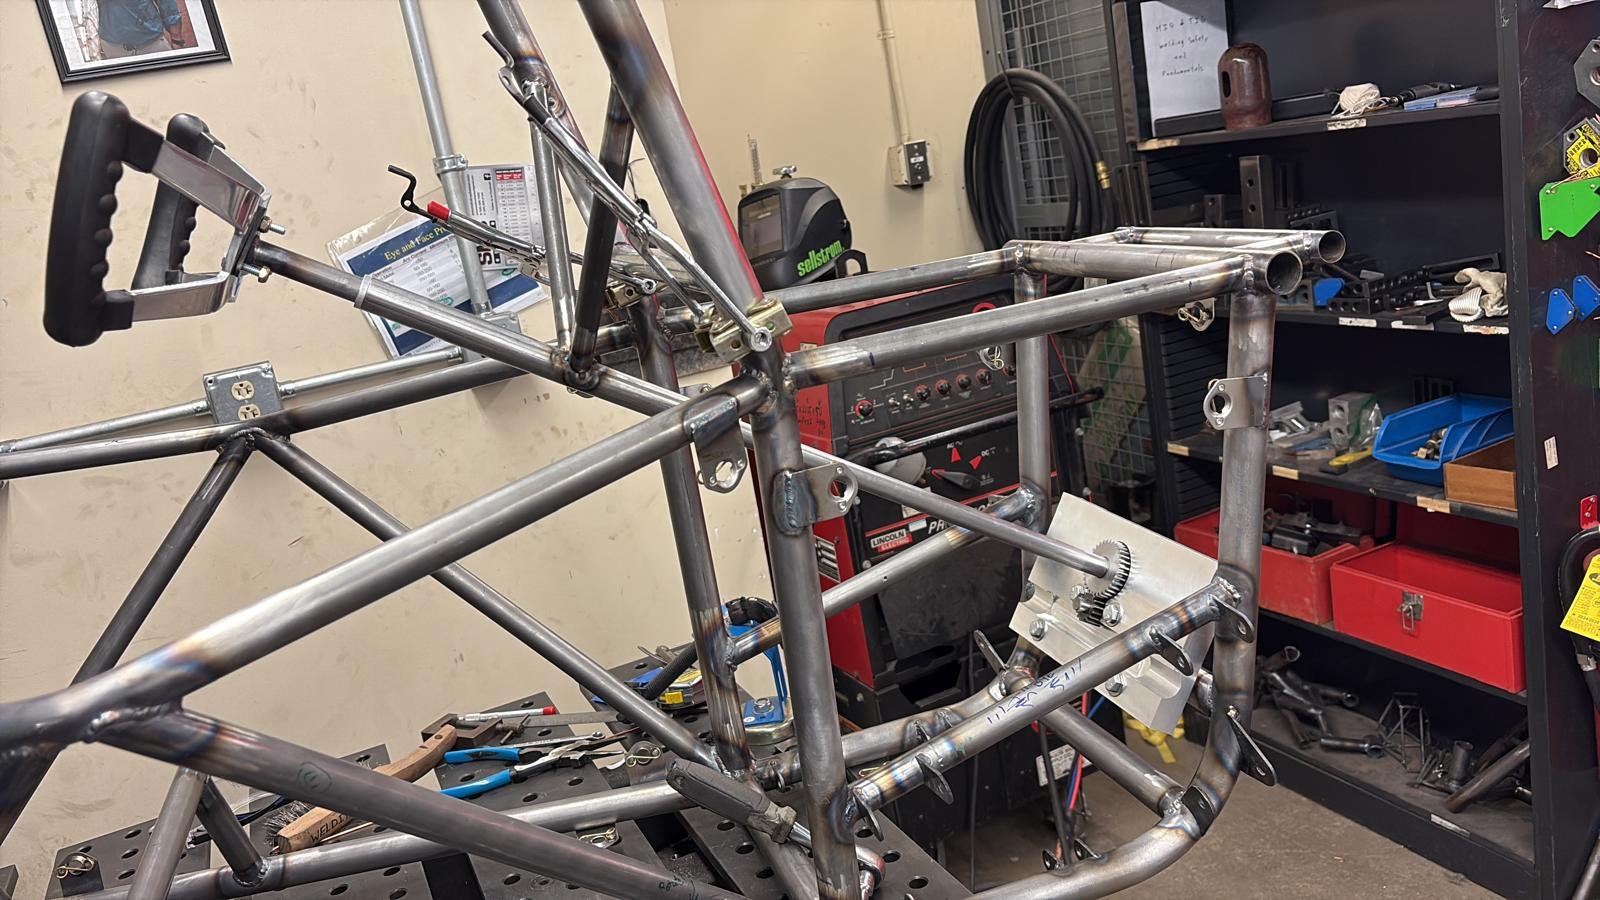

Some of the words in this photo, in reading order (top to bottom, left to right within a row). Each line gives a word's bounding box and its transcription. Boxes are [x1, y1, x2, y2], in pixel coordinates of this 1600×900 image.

[383, 248, 400, 260] Eye
[401, 239, 416, 253] and
[415, 231, 435, 246] Face
[797, 240, 842, 277] sellstrom
[872, 530, 906, 547] LINCOLN
[881, 536, 911, 550] ELECTRIC
